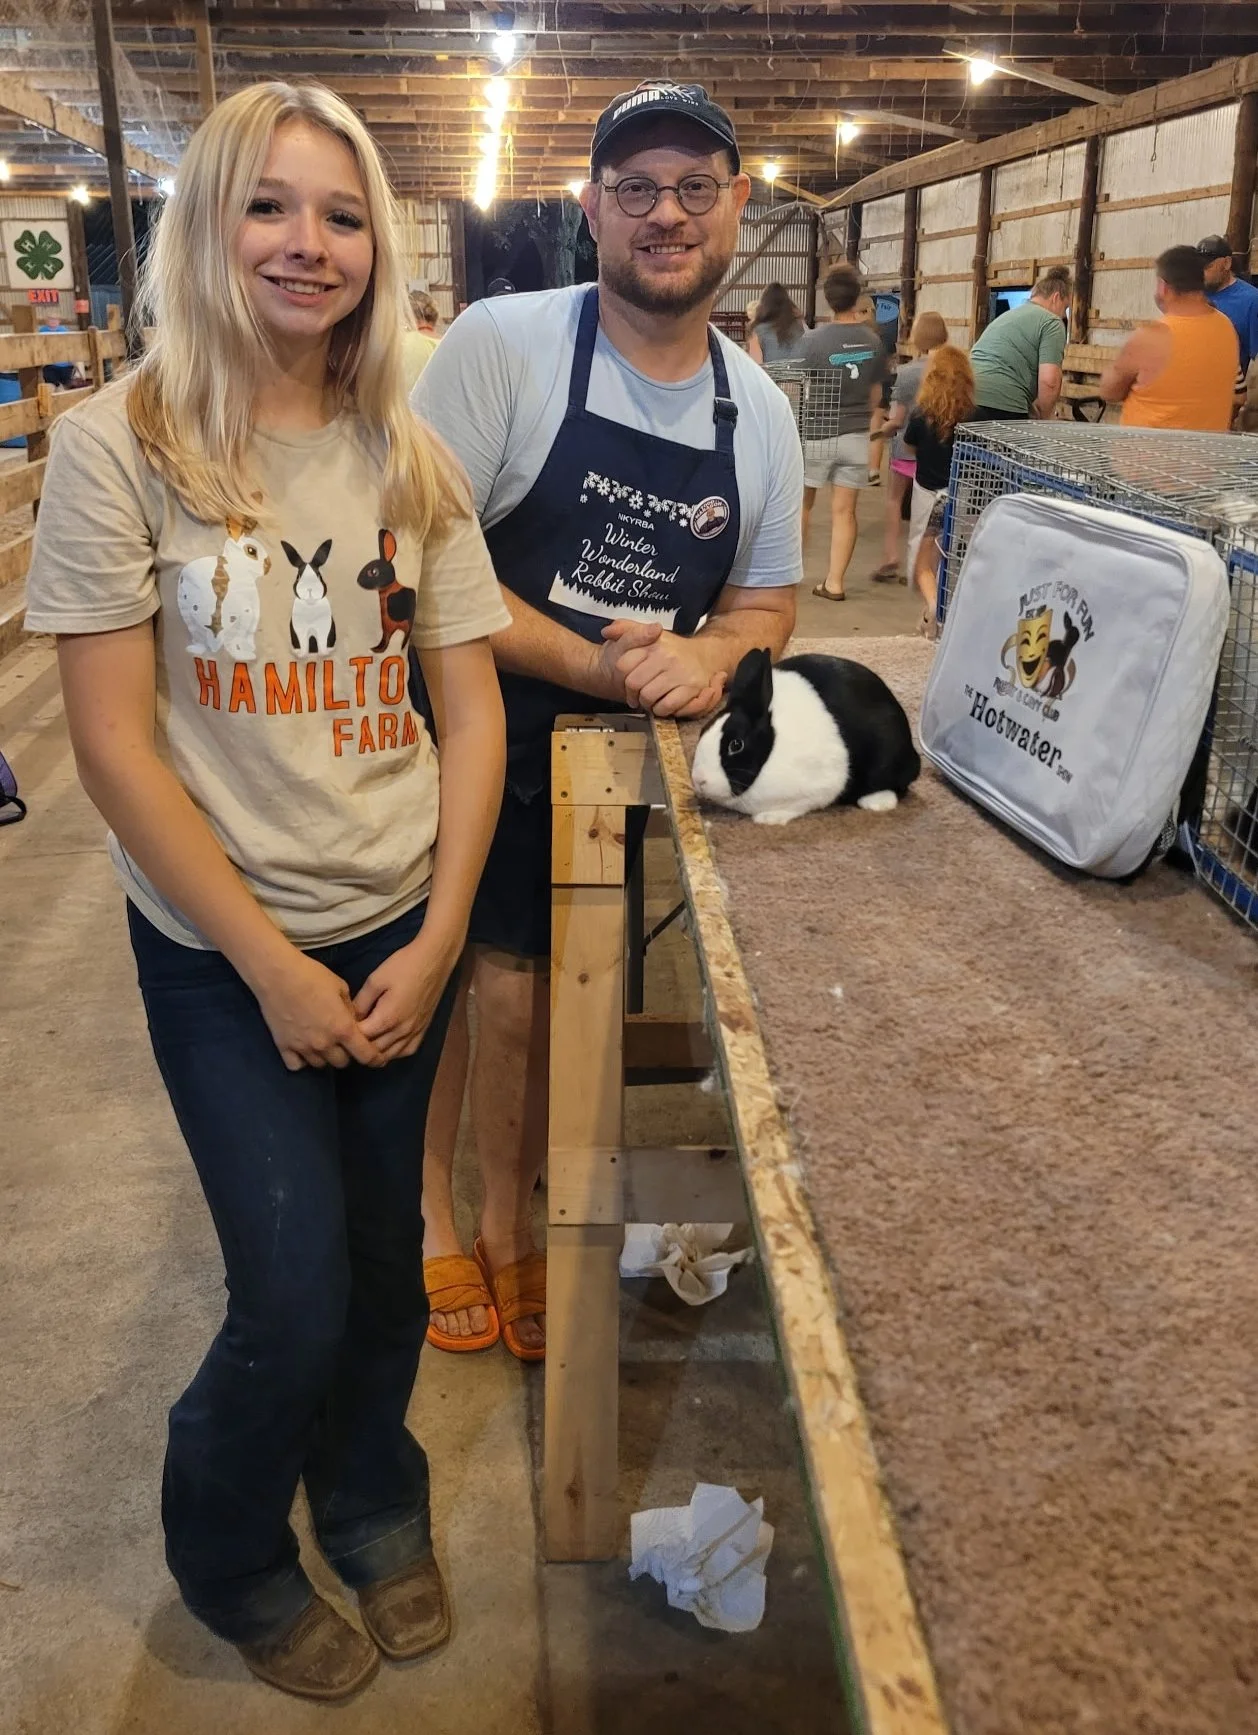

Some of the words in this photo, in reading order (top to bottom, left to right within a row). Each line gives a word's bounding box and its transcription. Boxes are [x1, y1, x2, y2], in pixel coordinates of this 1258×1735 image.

[28, 288, 59, 303] EXIT
[605, 523, 659, 556] Winter
[618, 512, 655, 531] NKYRBA
[571, 561, 625, 594] Rabbit
[581, 539, 681, 583] Wonderland
[1018, 582, 1052, 616] JUST
[1053, 581, 1078, 608] FOR
[1076, 598, 1095, 642] FUN
[332, 711, 419, 757] FARM
[969, 691, 1062, 768] Hotwater
